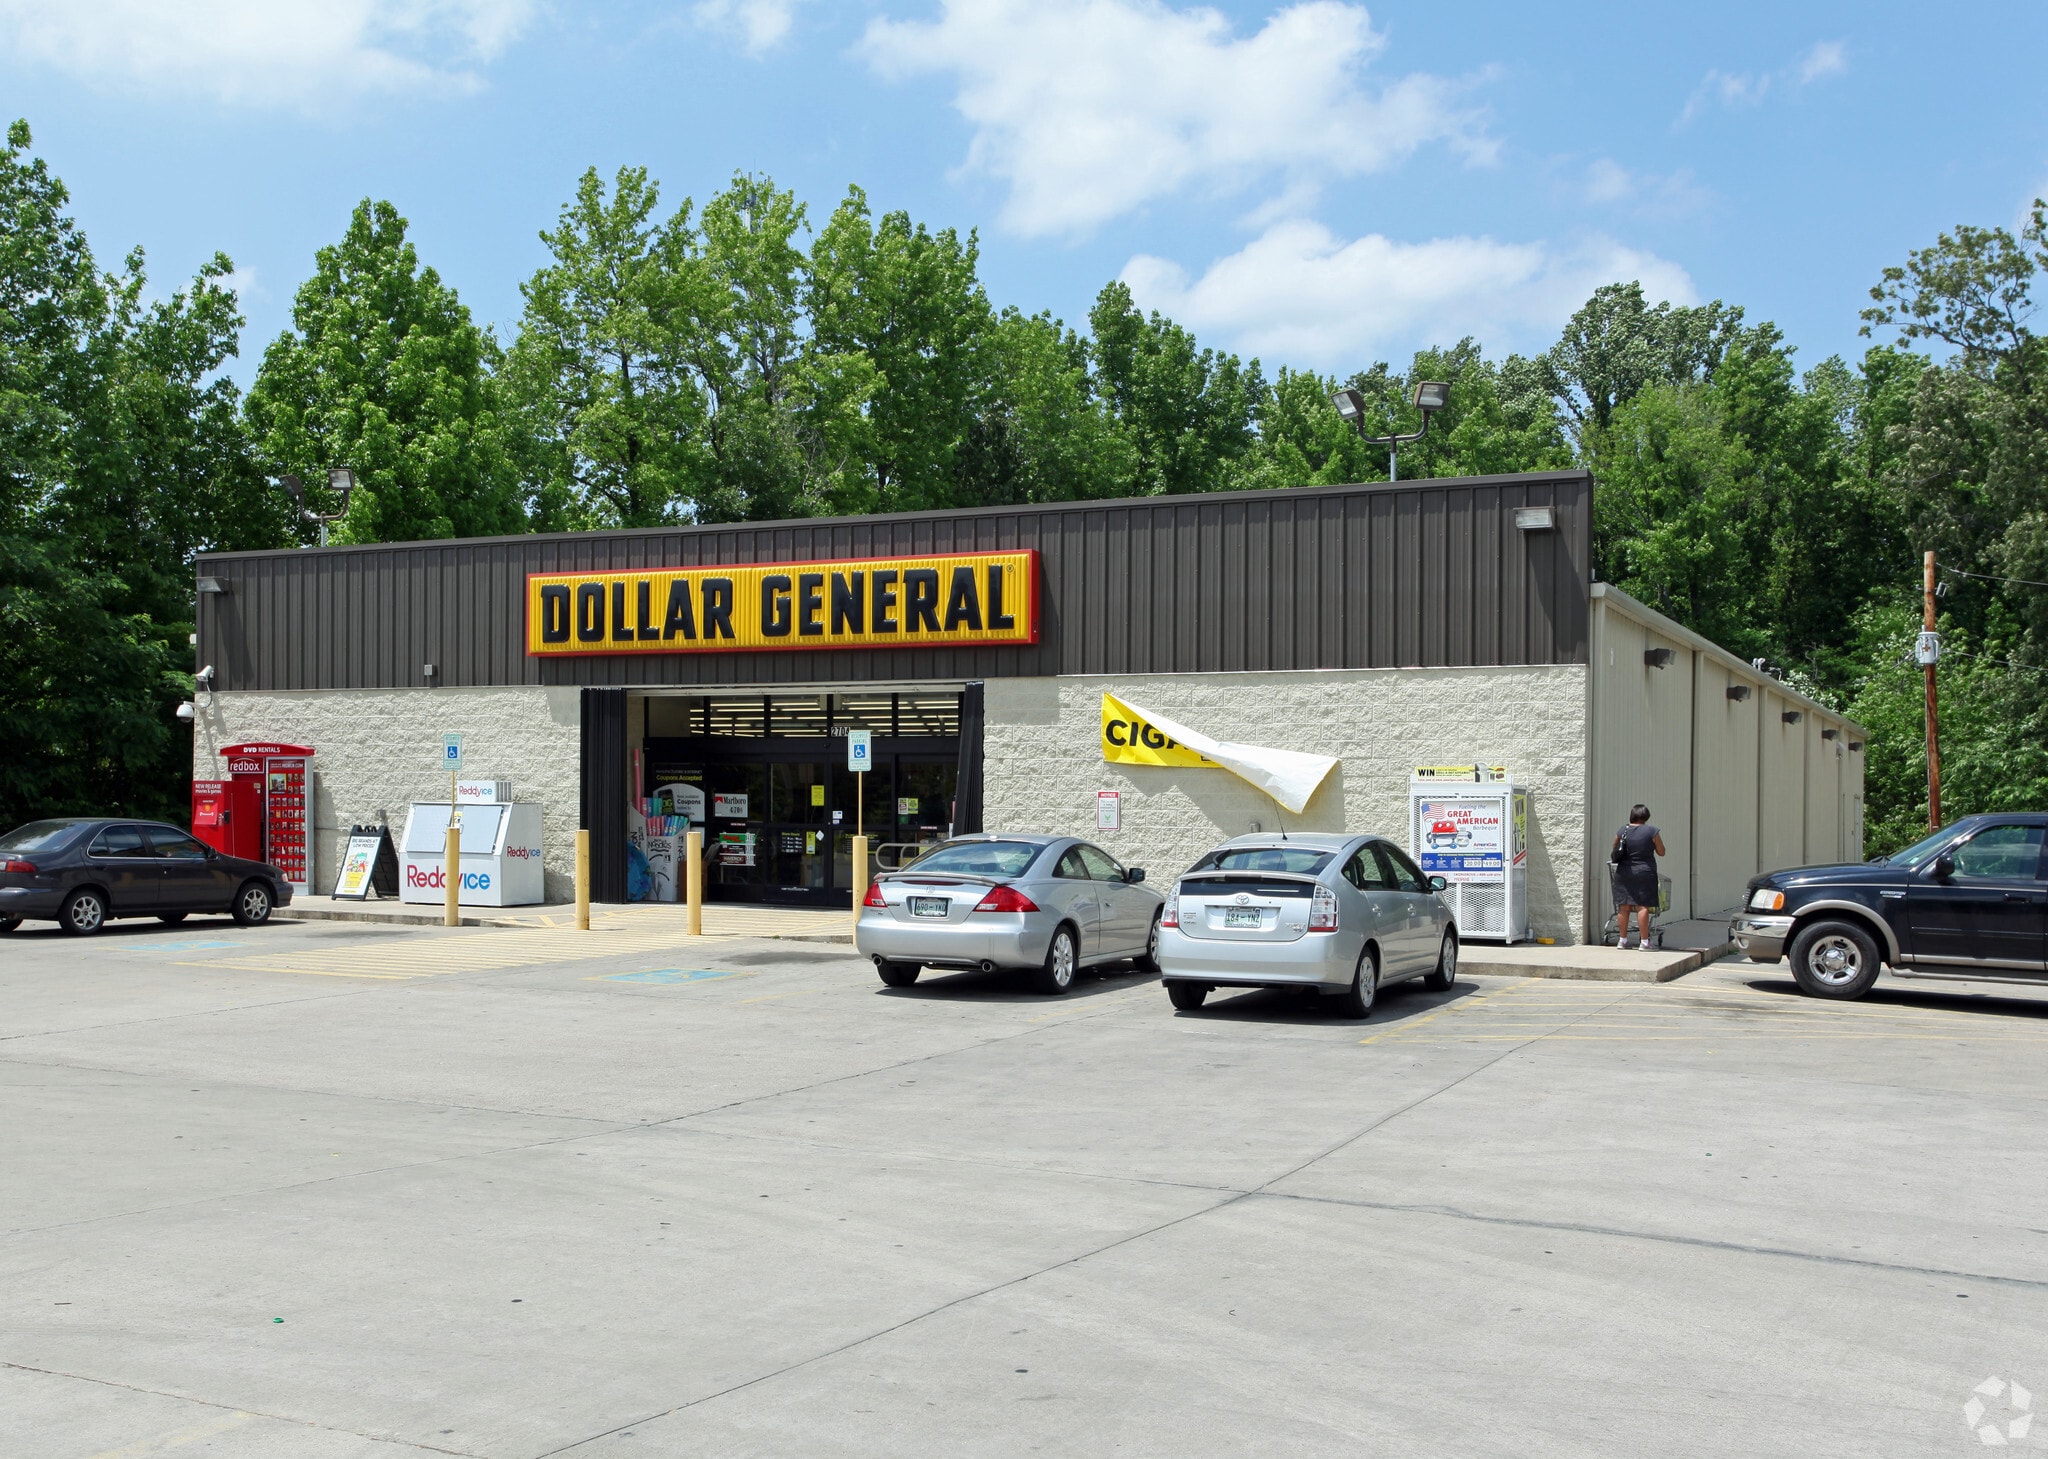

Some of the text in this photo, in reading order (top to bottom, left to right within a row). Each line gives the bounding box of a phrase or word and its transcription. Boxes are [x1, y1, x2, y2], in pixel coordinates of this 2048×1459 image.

[540, 563, 1014, 644] DOLLAR GENERAL
[230, 761, 260, 771] redbox
[1418, 769, 1435, 777] WIN
[724, 796, 746, 805] Marlboro
[1447, 810, 1472, 818] GREAT
